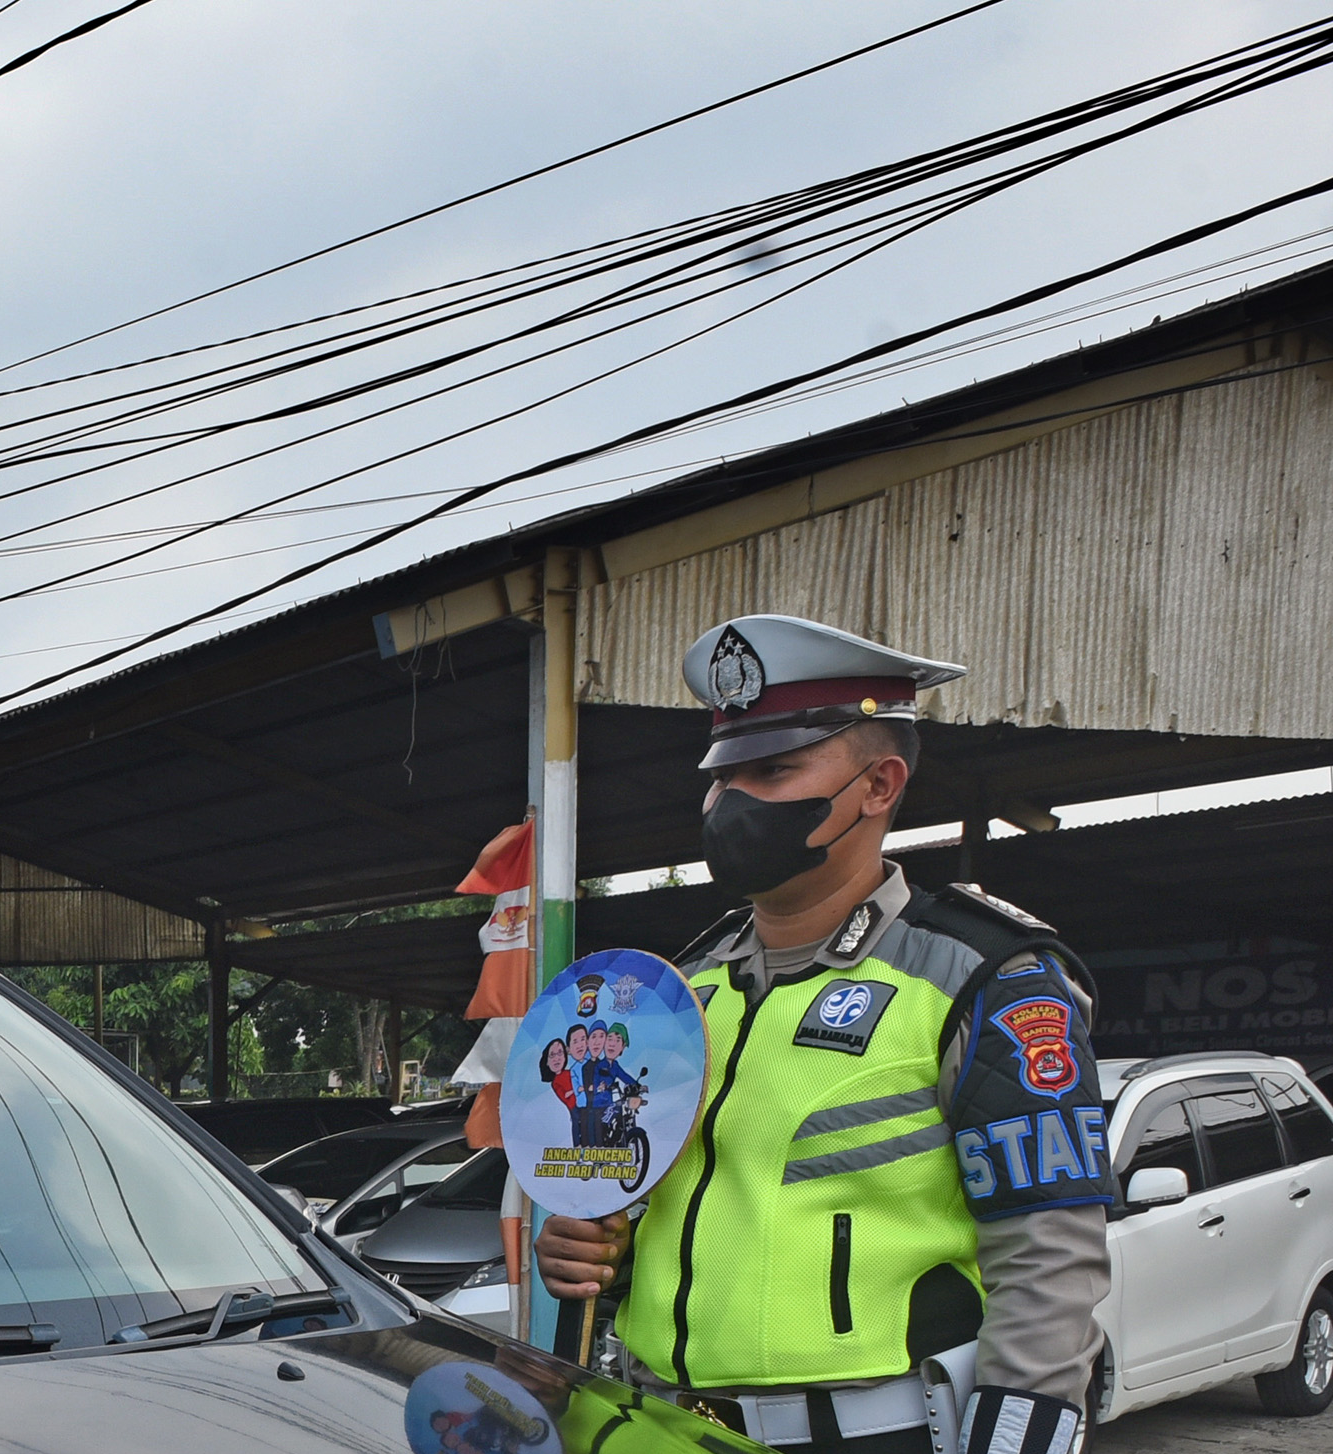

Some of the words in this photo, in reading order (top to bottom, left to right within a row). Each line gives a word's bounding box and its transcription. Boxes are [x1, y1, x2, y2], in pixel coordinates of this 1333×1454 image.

[1144, 960, 1318, 1013] NOS
[1160, 1014, 1229, 1033] BELI
[1022, 1026, 1061, 1039] BANTEN
[543, 1148, 581, 1161] JANGAN
[583, 1148, 632, 1162] BONCENG
[955, 1107, 1105, 1198] STAF
[534, 1163, 565, 1177] LEBIH
[566, 1164, 592, 1178] DARI
[601, 1165, 637, 1179] ORANG
